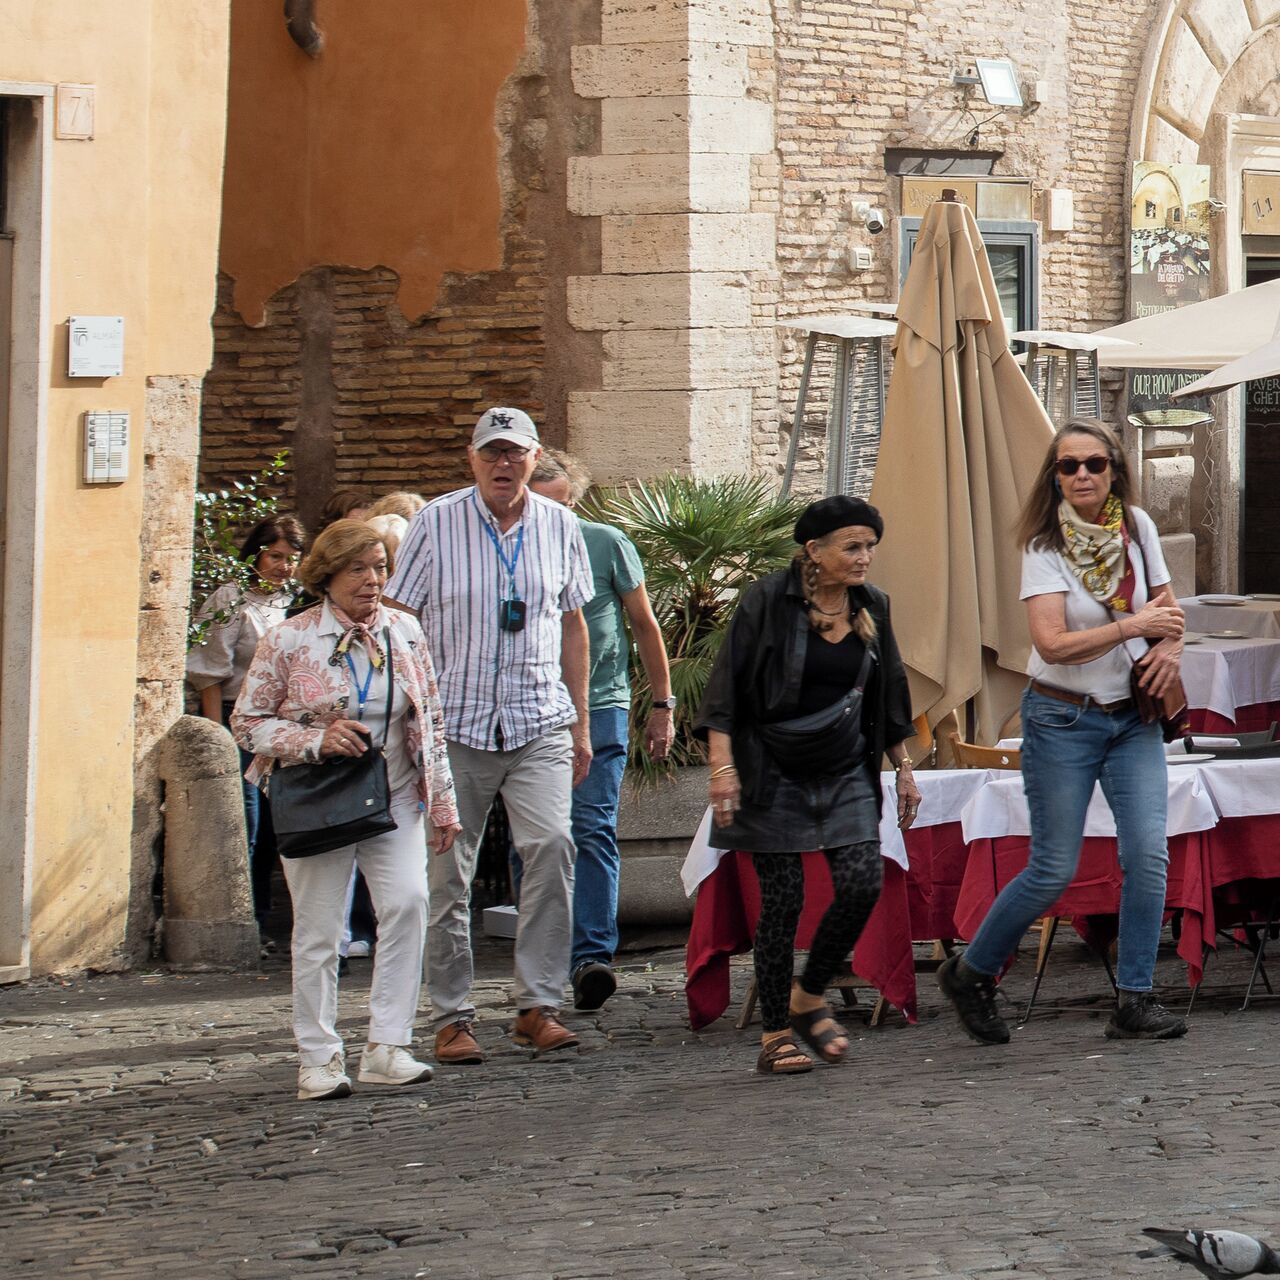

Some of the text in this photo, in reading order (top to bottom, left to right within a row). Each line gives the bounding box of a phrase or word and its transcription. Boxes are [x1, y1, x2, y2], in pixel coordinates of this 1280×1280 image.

[1133, 374, 1152, 400] OUR
[1152, 373, 1177, 400] ROOM
[489, 413, 515, 430] NY
